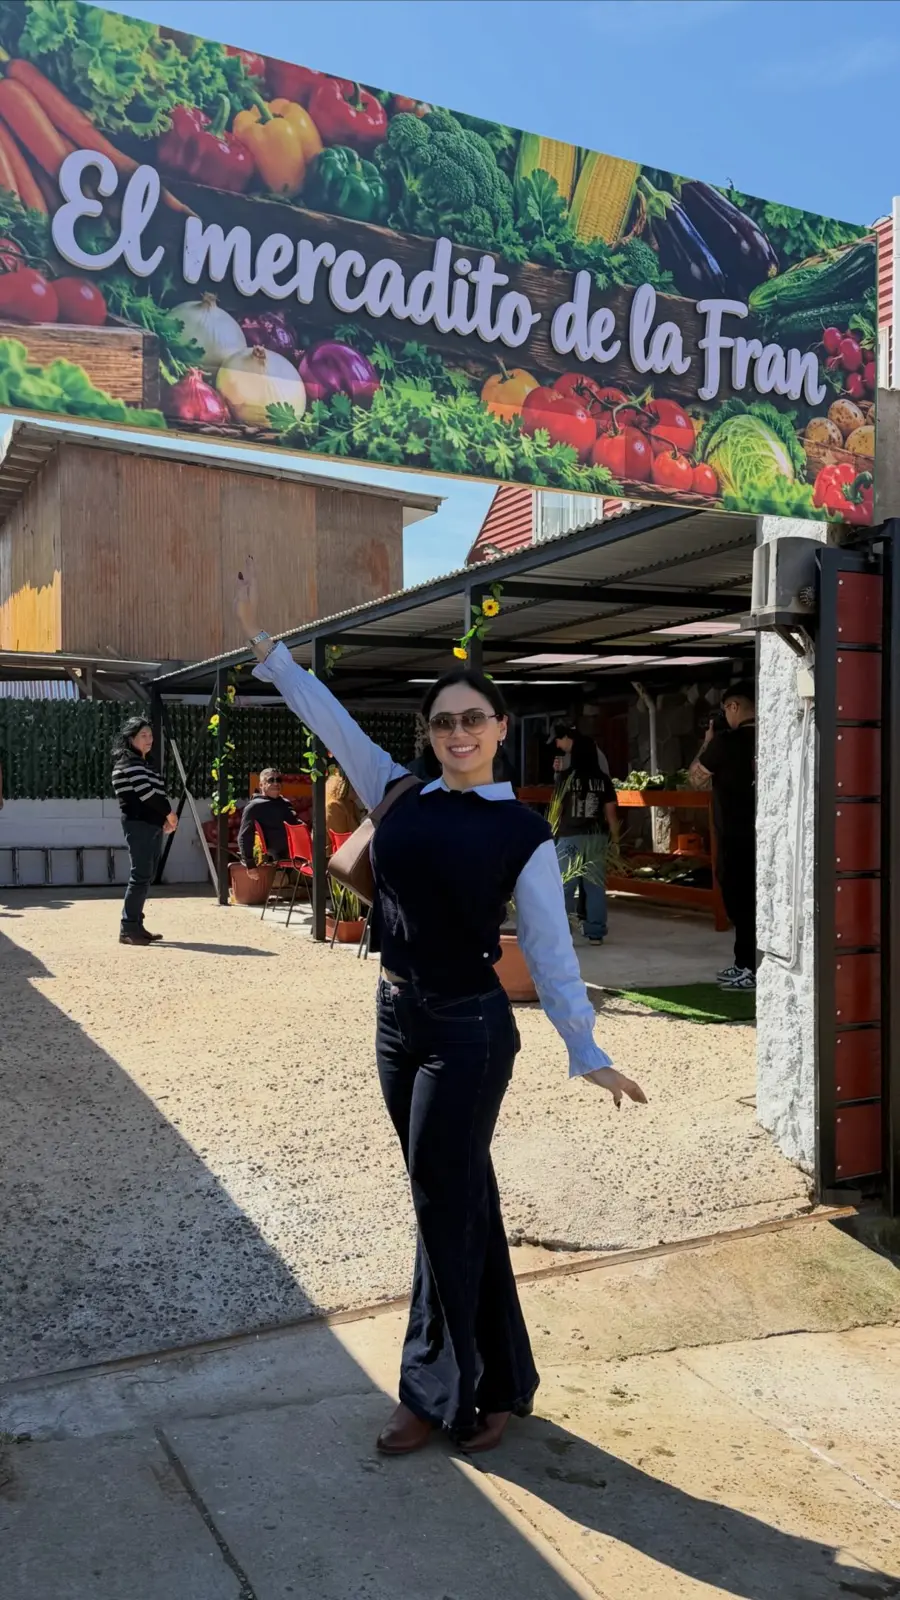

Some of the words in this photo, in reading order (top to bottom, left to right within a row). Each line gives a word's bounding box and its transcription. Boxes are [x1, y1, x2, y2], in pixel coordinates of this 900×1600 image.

[51, 149, 166, 277] El
[182, 215, 541, 348] mercadito
[551, 270, 621, 363] de
[630, 283, 691, 375] la
[696, 298, 827, 406] Fran
